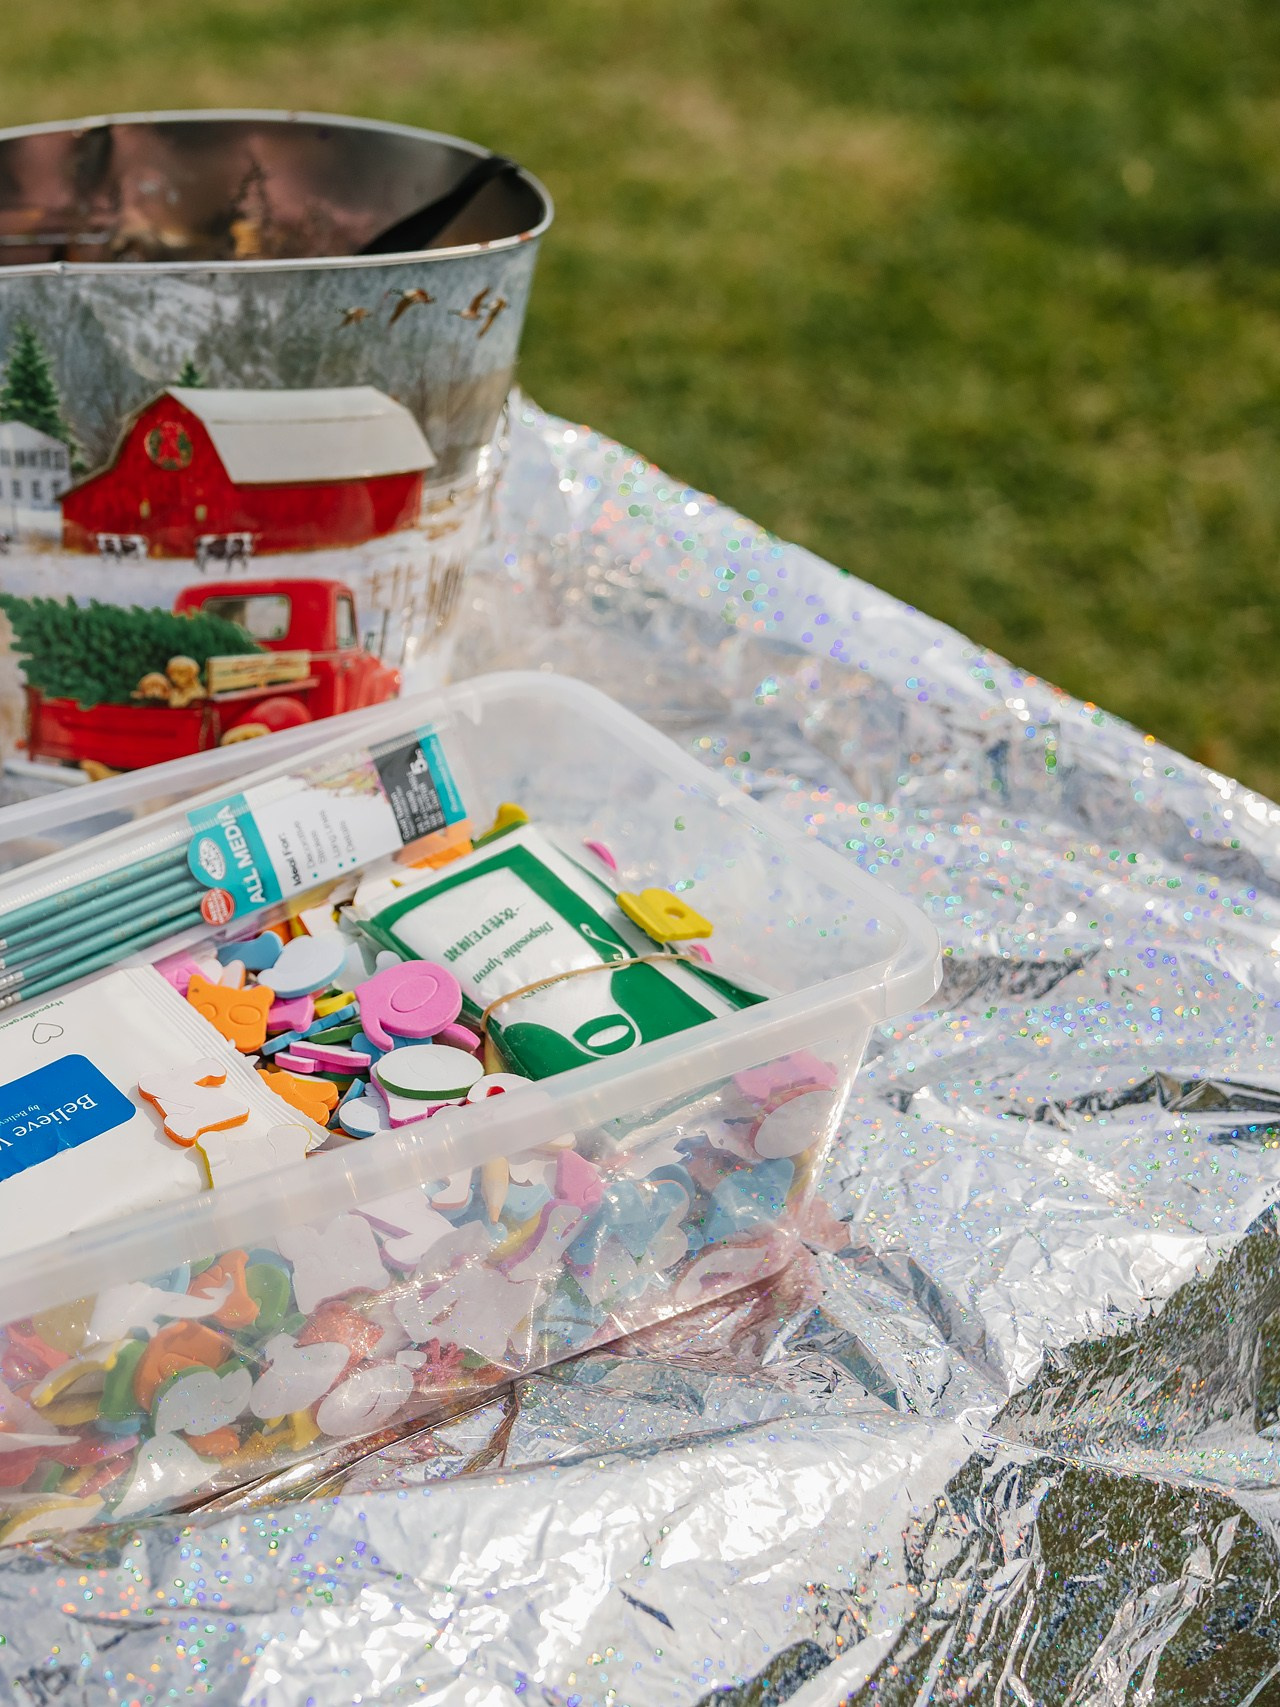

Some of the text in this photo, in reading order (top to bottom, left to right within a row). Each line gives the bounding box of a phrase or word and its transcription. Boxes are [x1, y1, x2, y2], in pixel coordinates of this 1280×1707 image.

[217, 804, 267, 906] ALL MEDIA
[473, 921, 553, 984] Disposable Apron
[15, 1094, 97, 1137] Believe
[27, 1103, 40, 1113] by
